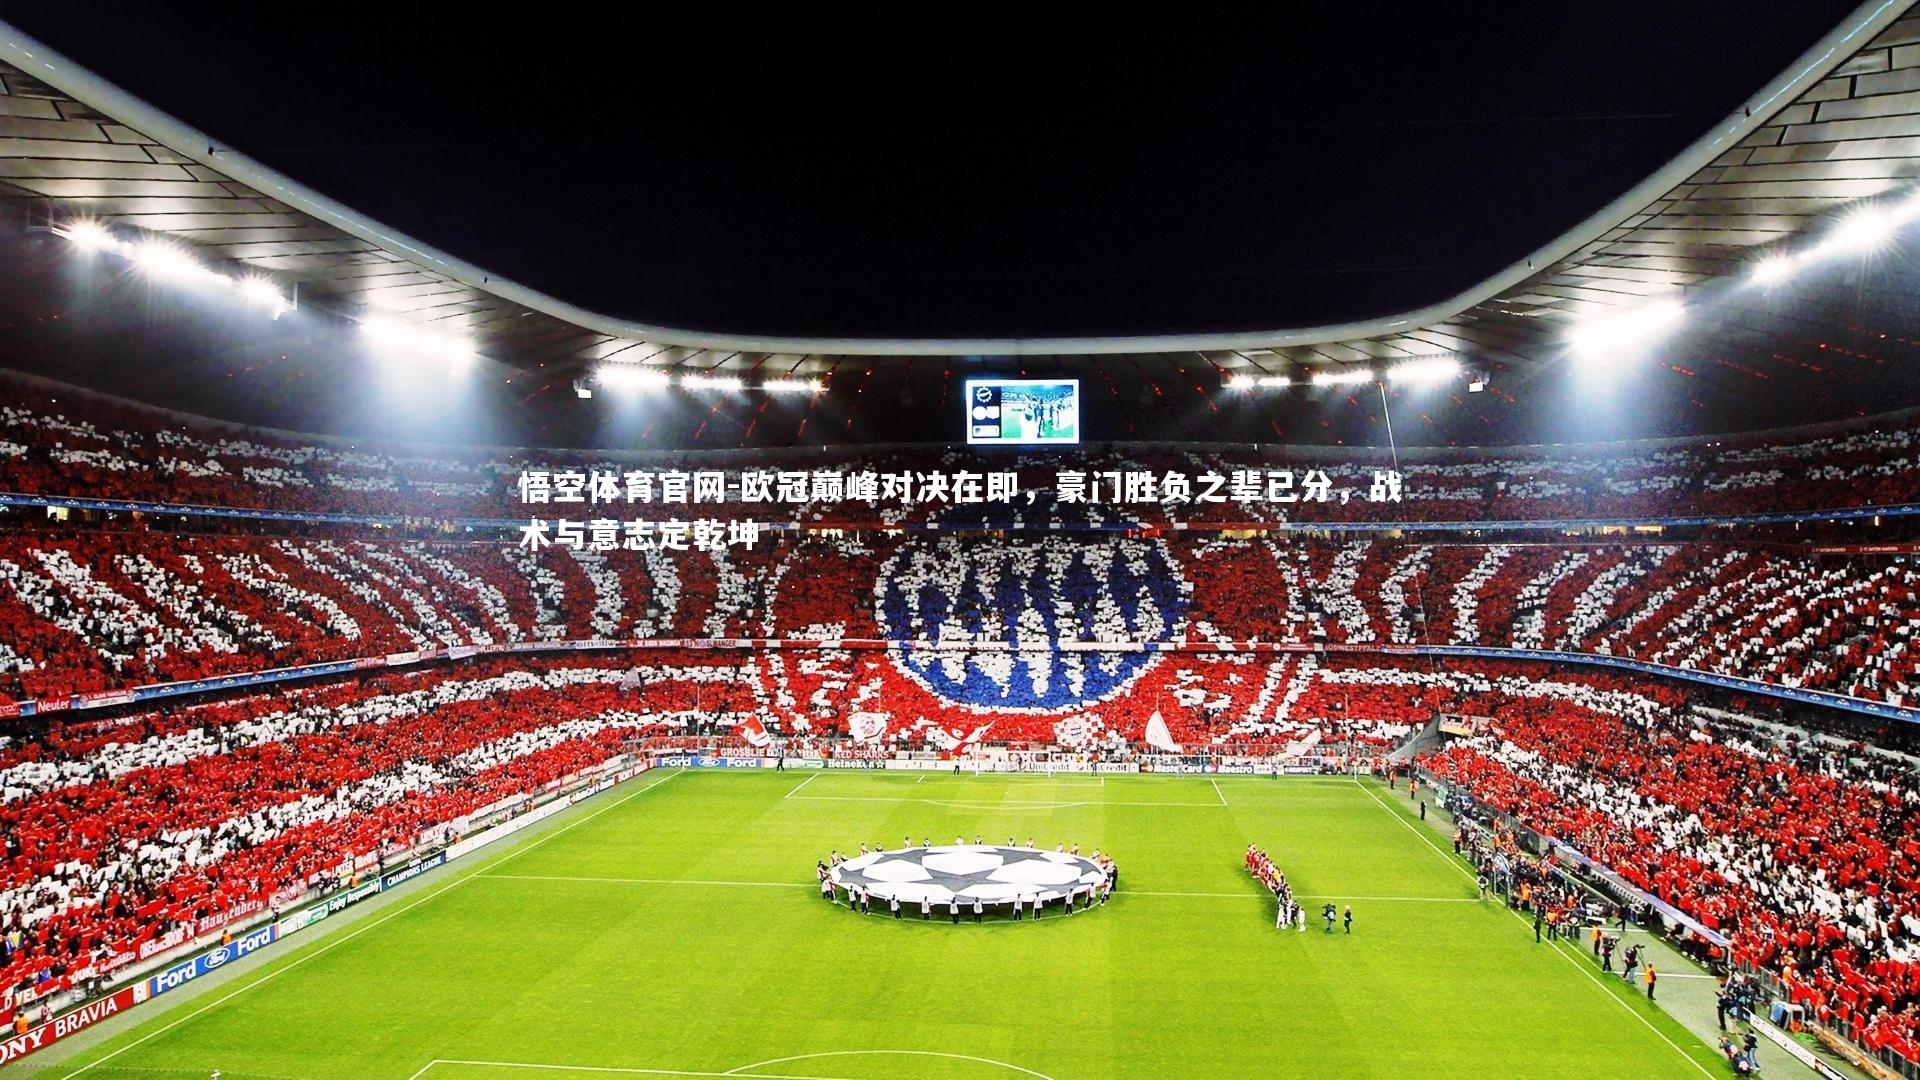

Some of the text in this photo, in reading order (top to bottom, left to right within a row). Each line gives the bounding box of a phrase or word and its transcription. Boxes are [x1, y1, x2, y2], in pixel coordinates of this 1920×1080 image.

[37, 700, 70, 712] Neuler
[661, 757, 692, 767] Ford
[727, 758, 756, 768] Ford
[387, 855, 442, 887] CHAMPIONS LEAGUE
[329, 896, 347, 912] Enjoy
[157, 960, 196, 993] Ford
[238, 927, 270, 956] Ford
[55, 998, 118, 1038] BRAVIA
